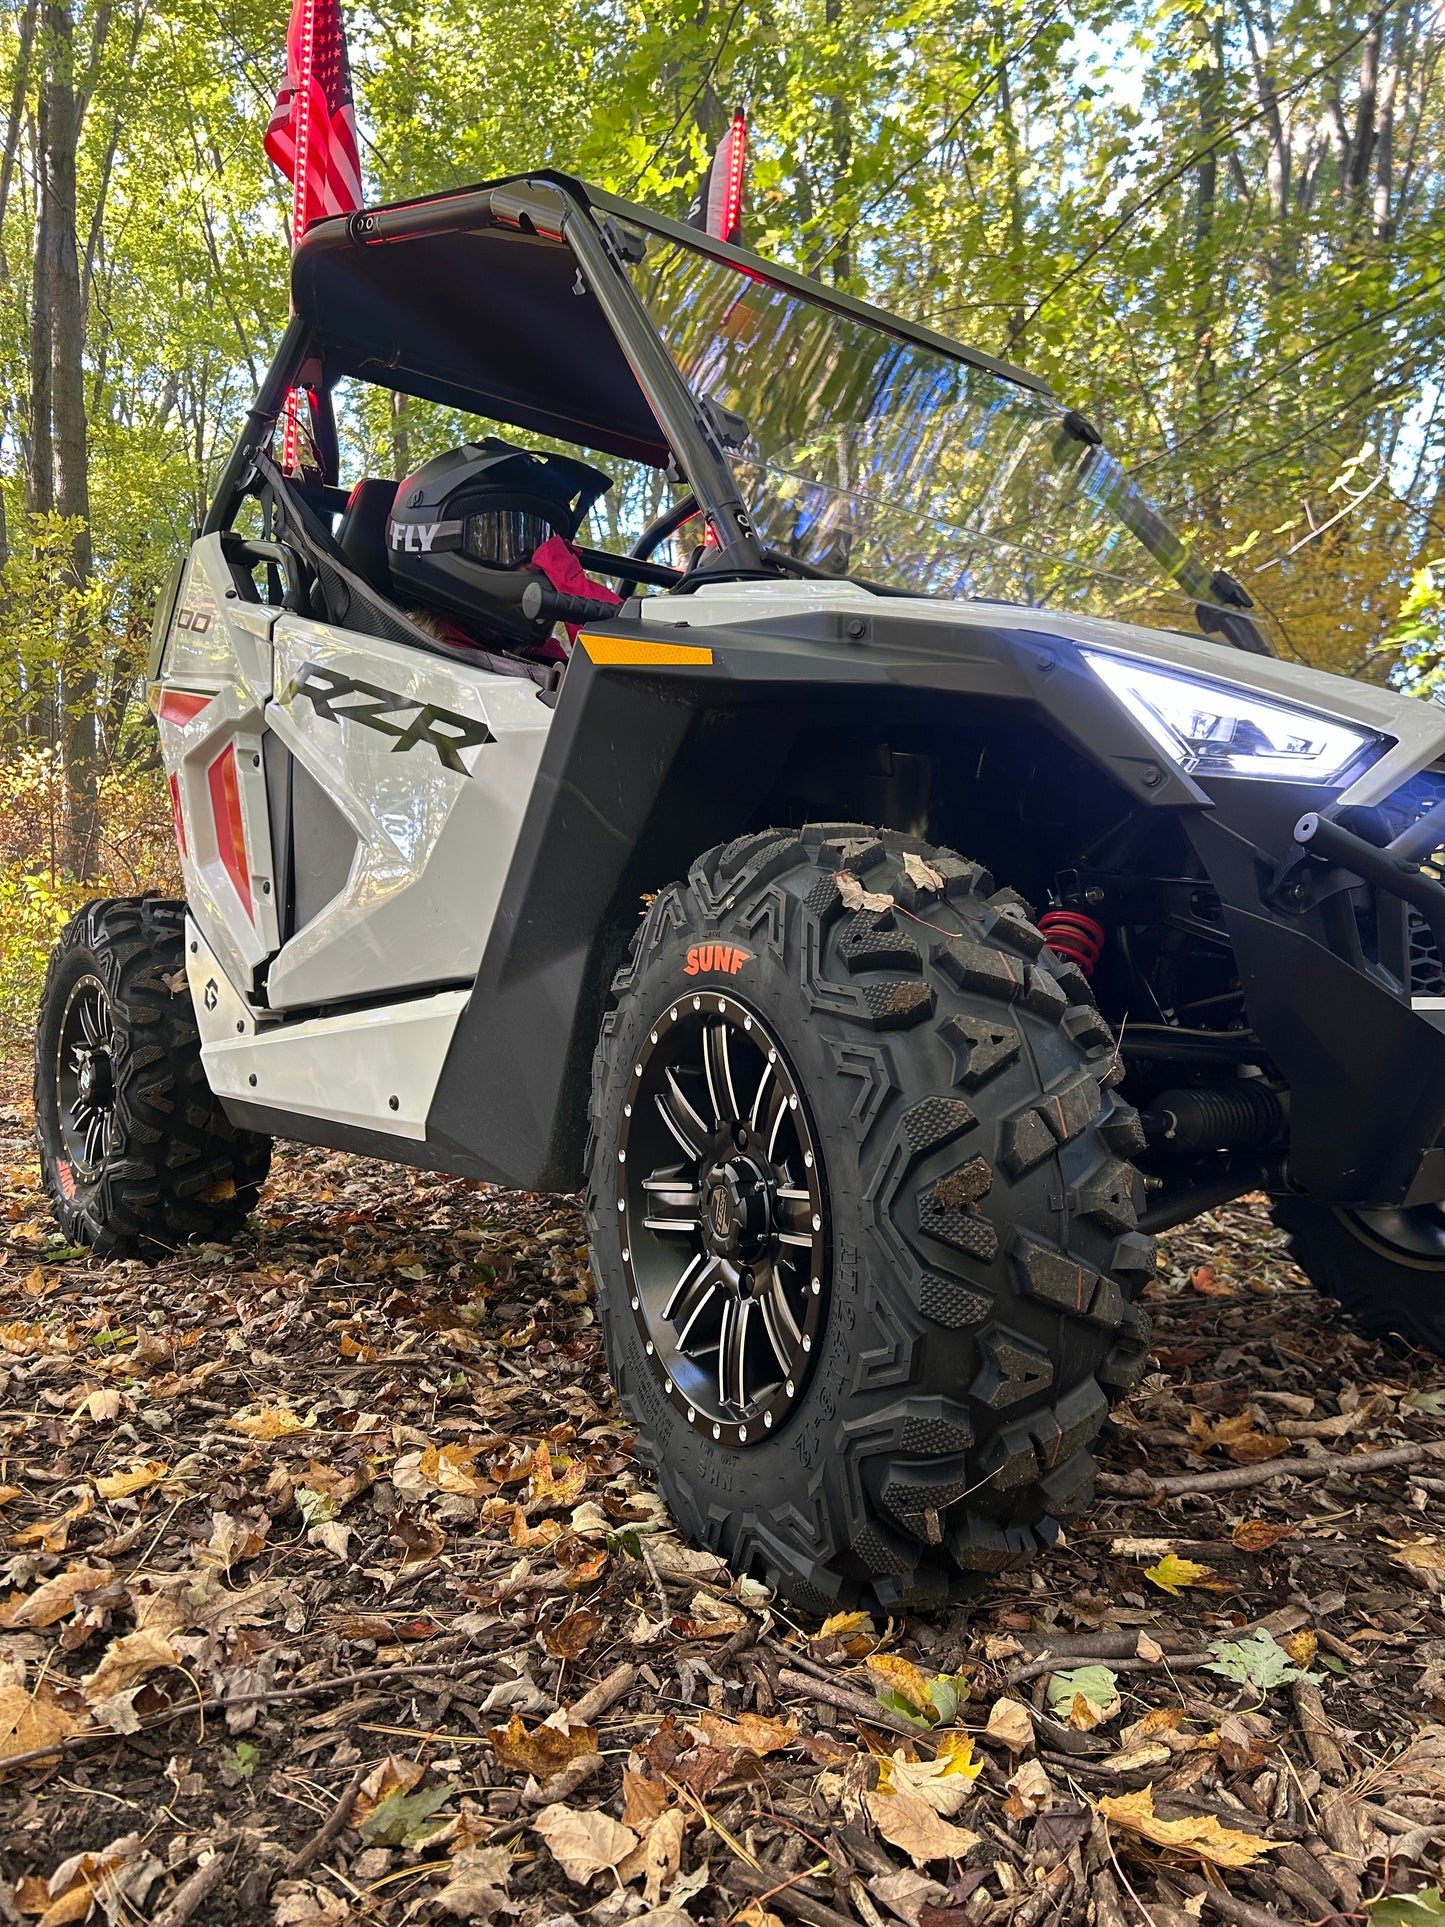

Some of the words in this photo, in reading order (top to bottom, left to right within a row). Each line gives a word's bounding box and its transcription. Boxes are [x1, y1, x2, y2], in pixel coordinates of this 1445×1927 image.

[392, 523, 441, 552] FLY
[279, 661, 498, 778] RZR
[683, 945, 750, 976] SUNF
